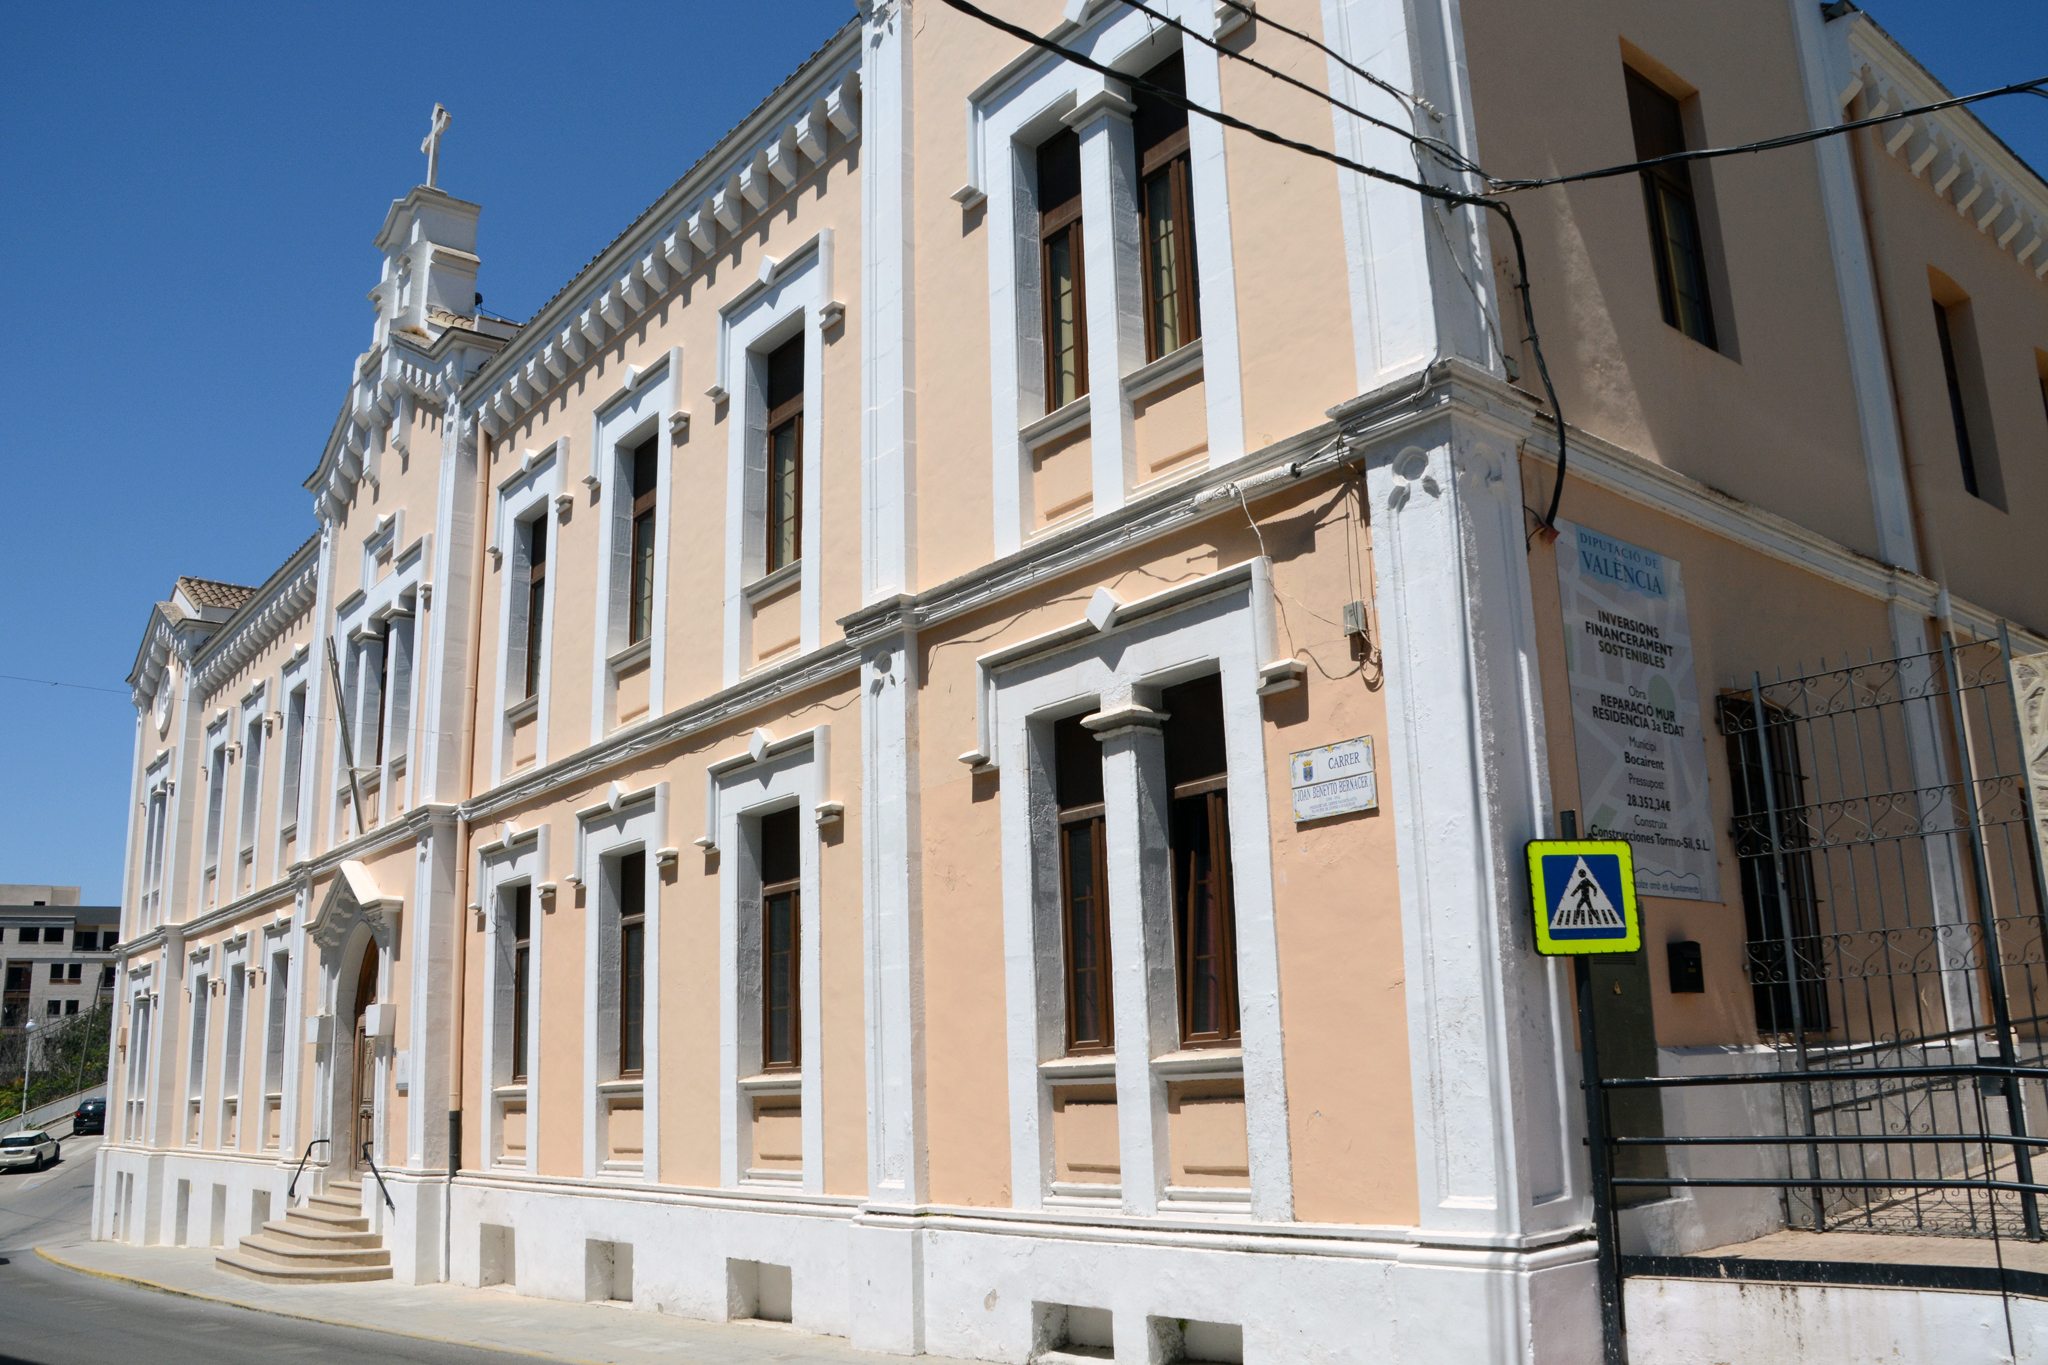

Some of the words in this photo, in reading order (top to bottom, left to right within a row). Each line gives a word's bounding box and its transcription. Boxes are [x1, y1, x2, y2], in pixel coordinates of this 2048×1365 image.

[1580, 532, 1641, 563] DIPUTACIÓ
[1645, 556, 1659, 569] DE
[1581, 551, 1663, 594] VALÈNCIA
[1598, 610, 1659, 639] INVERSIONS
[1585, 621, 1673, 657] FINANCERAMENT
[1598, 640, 1666, 669] SOSTENIBLES
[1628, 686, 1647, 700] Obra
[1600, 694, 1653, 717] REPARACIÓ
[1655, 707, 1676, 722] MUR
[1651, 720, 1661, 732] 3a
[1663, 722, 1685, 737] EDAT
[1629, 736, 1657, 754] Municipi
[1328, 752, 1360, 770] CARRER
[1624, 751, 1665, 770] Bocairent
[1628, 773, 1665, 791] Pressupost
[1297, 789, 1312, 802] JOAN
[1313, 782, 1338, 799] BENEYTO
[1626, 794, 1671, 812] 28.352,34€
[1634, 815, 1668, 830] Construix
[1591, 824, 1655, 844] Construcciones
[1696, 839, 1710, 851] S.L.
